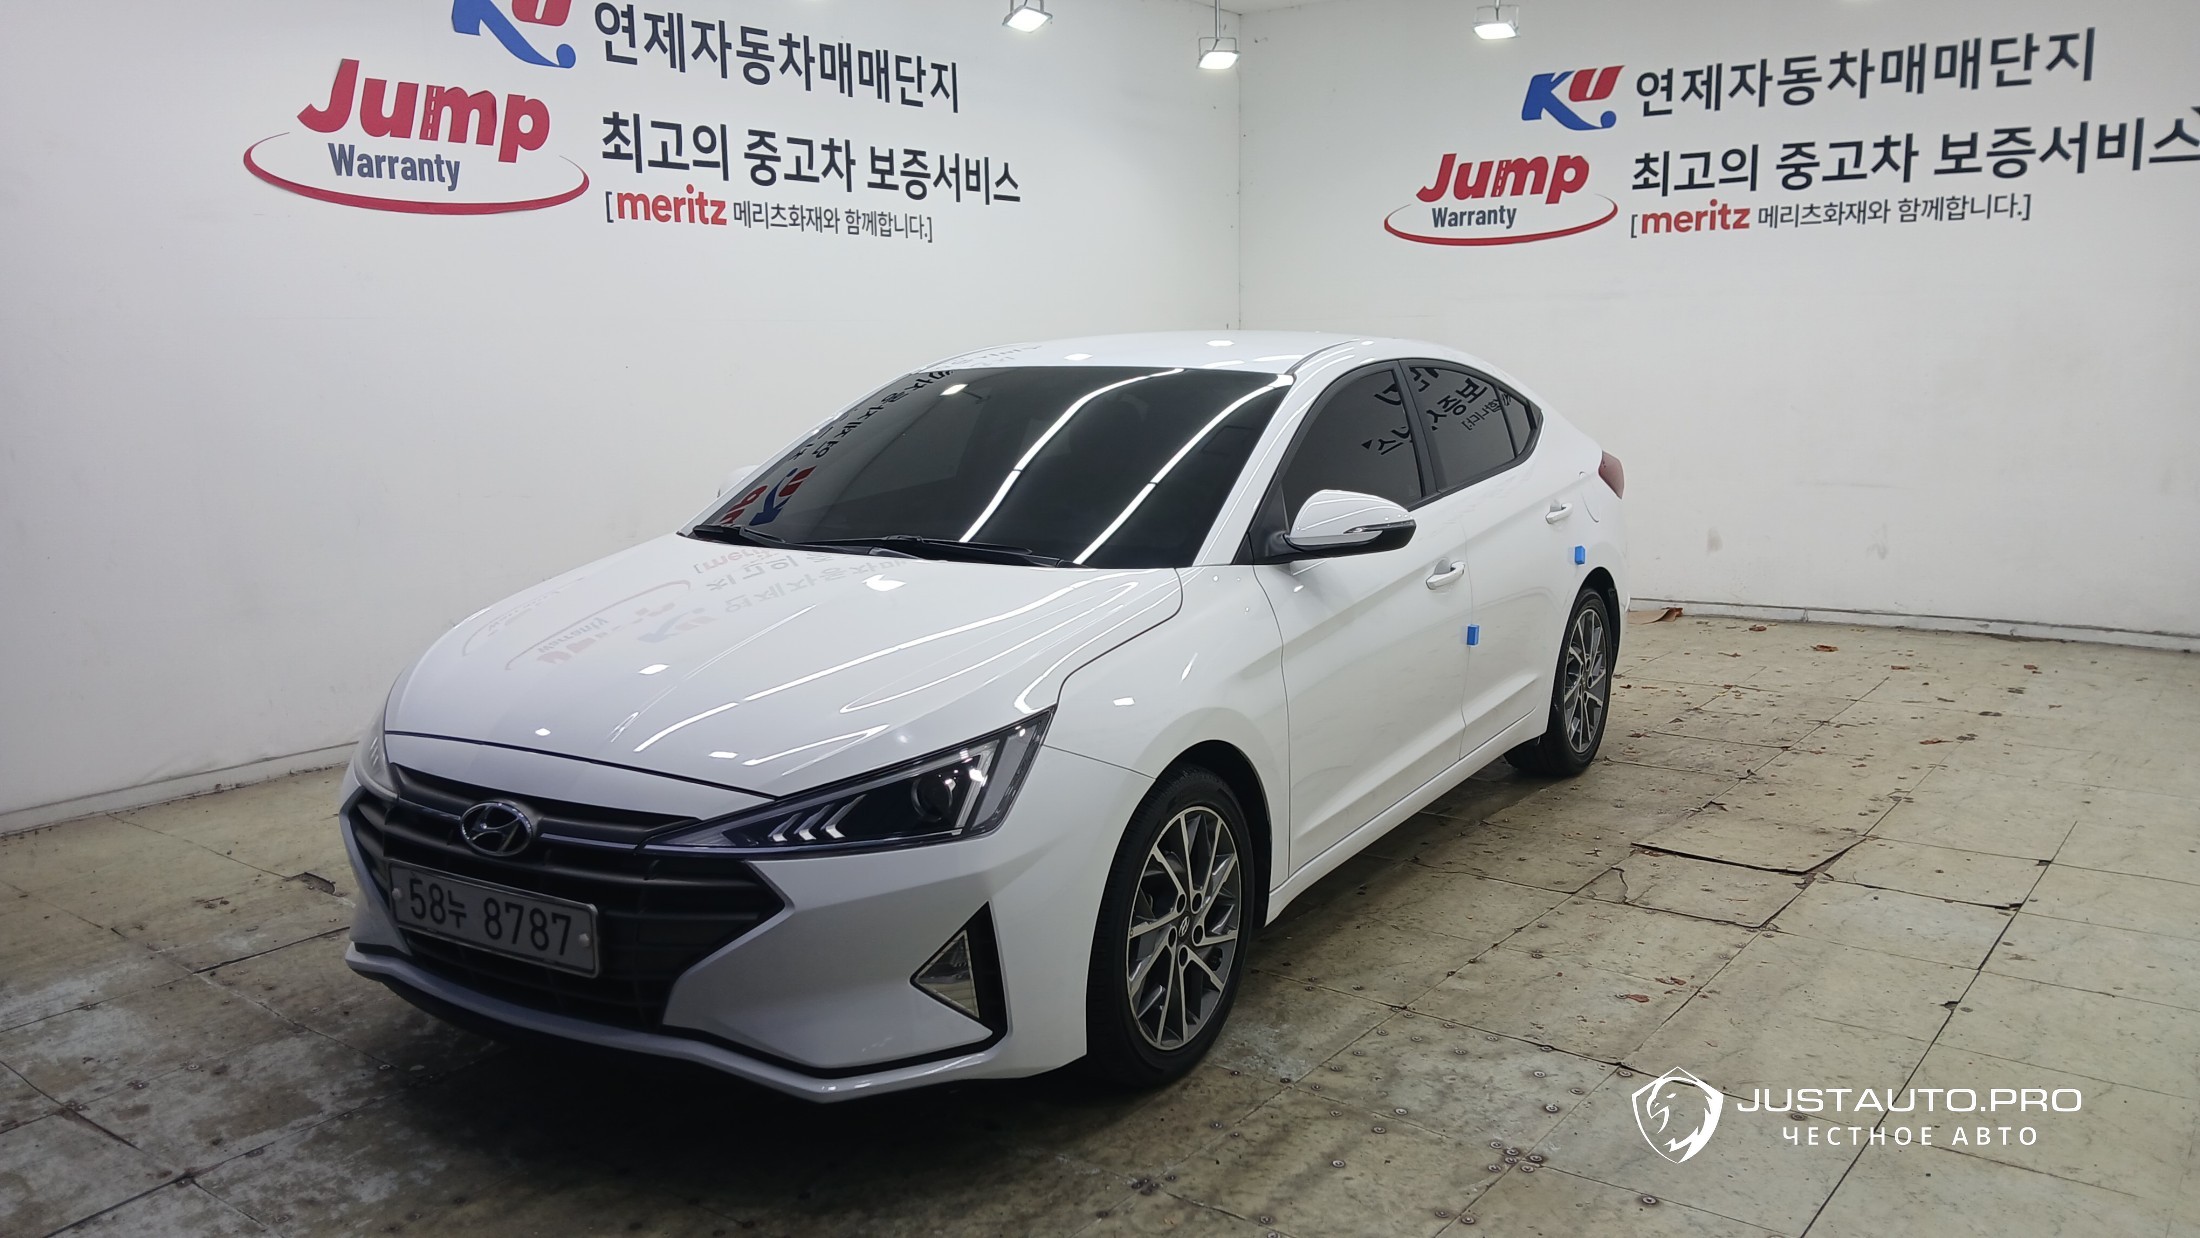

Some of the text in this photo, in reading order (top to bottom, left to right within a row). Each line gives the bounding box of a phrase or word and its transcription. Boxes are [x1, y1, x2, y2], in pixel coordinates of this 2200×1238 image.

[594, 2, 959, 114] 연제자동차매매단지
[1636, 27, 2096, 118] 연제자동차매매단지
[296, 58, 550, 163] Jump
[328, 142, 461, 192] Warranty
[602, 111, 1021, 206] 최고의 중고차 보증서비스
[1416, 153, 1590, 205] Jump
[1631, 117, 2200, 197] 최고의 중고차 보증서비스
[733, 201, 841, 234] 메리츠화재와
[1431, 205, 1517, 230] Warranty
[1757, 199, 1892, 229] 메리츠화재와
[483, 898, 572, 956] 8787
